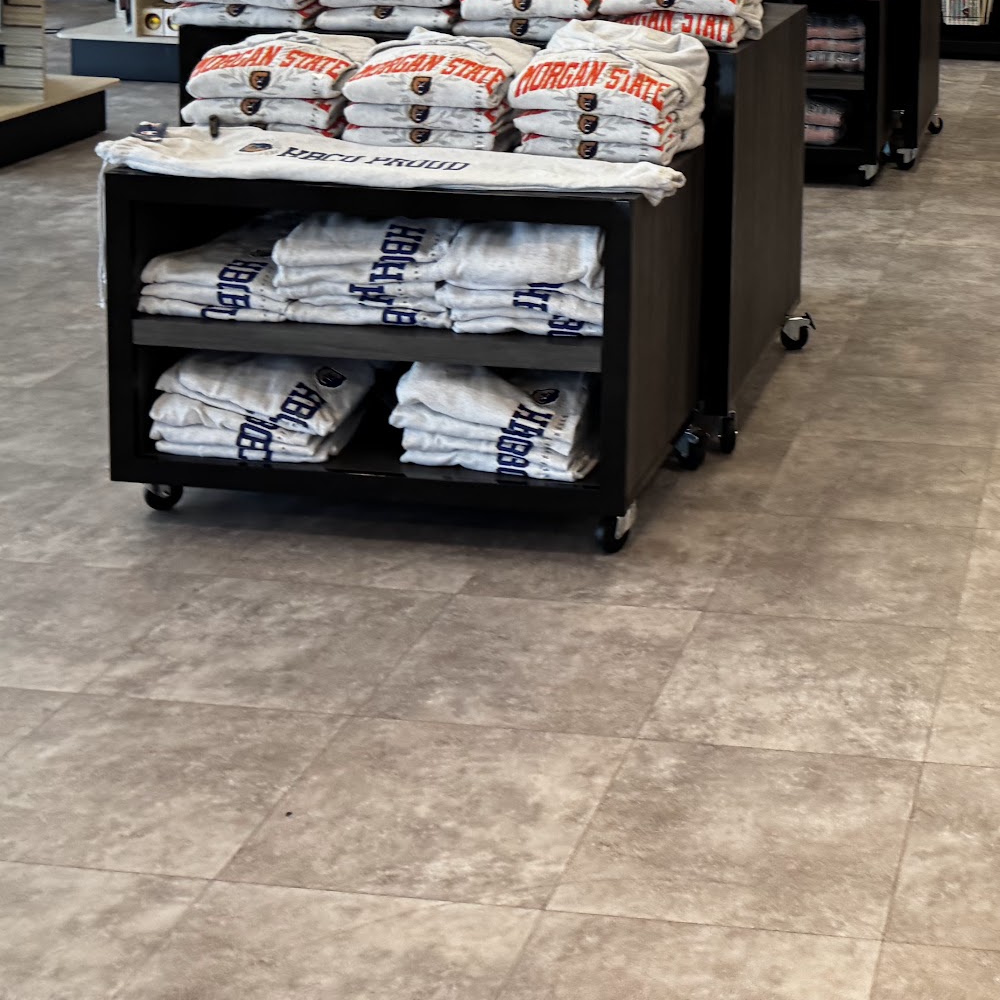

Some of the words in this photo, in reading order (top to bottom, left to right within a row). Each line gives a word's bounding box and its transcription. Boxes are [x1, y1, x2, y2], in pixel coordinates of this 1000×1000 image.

[190, 46, 283, 78] MORGAN
[279, 49, 351, 81] STATE
[348, 54, 446, 83] MORGAN
[440, 57, 507, 95] STATE
[514, 61, 609, 98] MORGAN
[604, 67, 671, 111] STATE
[277, 146, 366, 164] HBCU
[364, 155, 471, 172] PROUD
